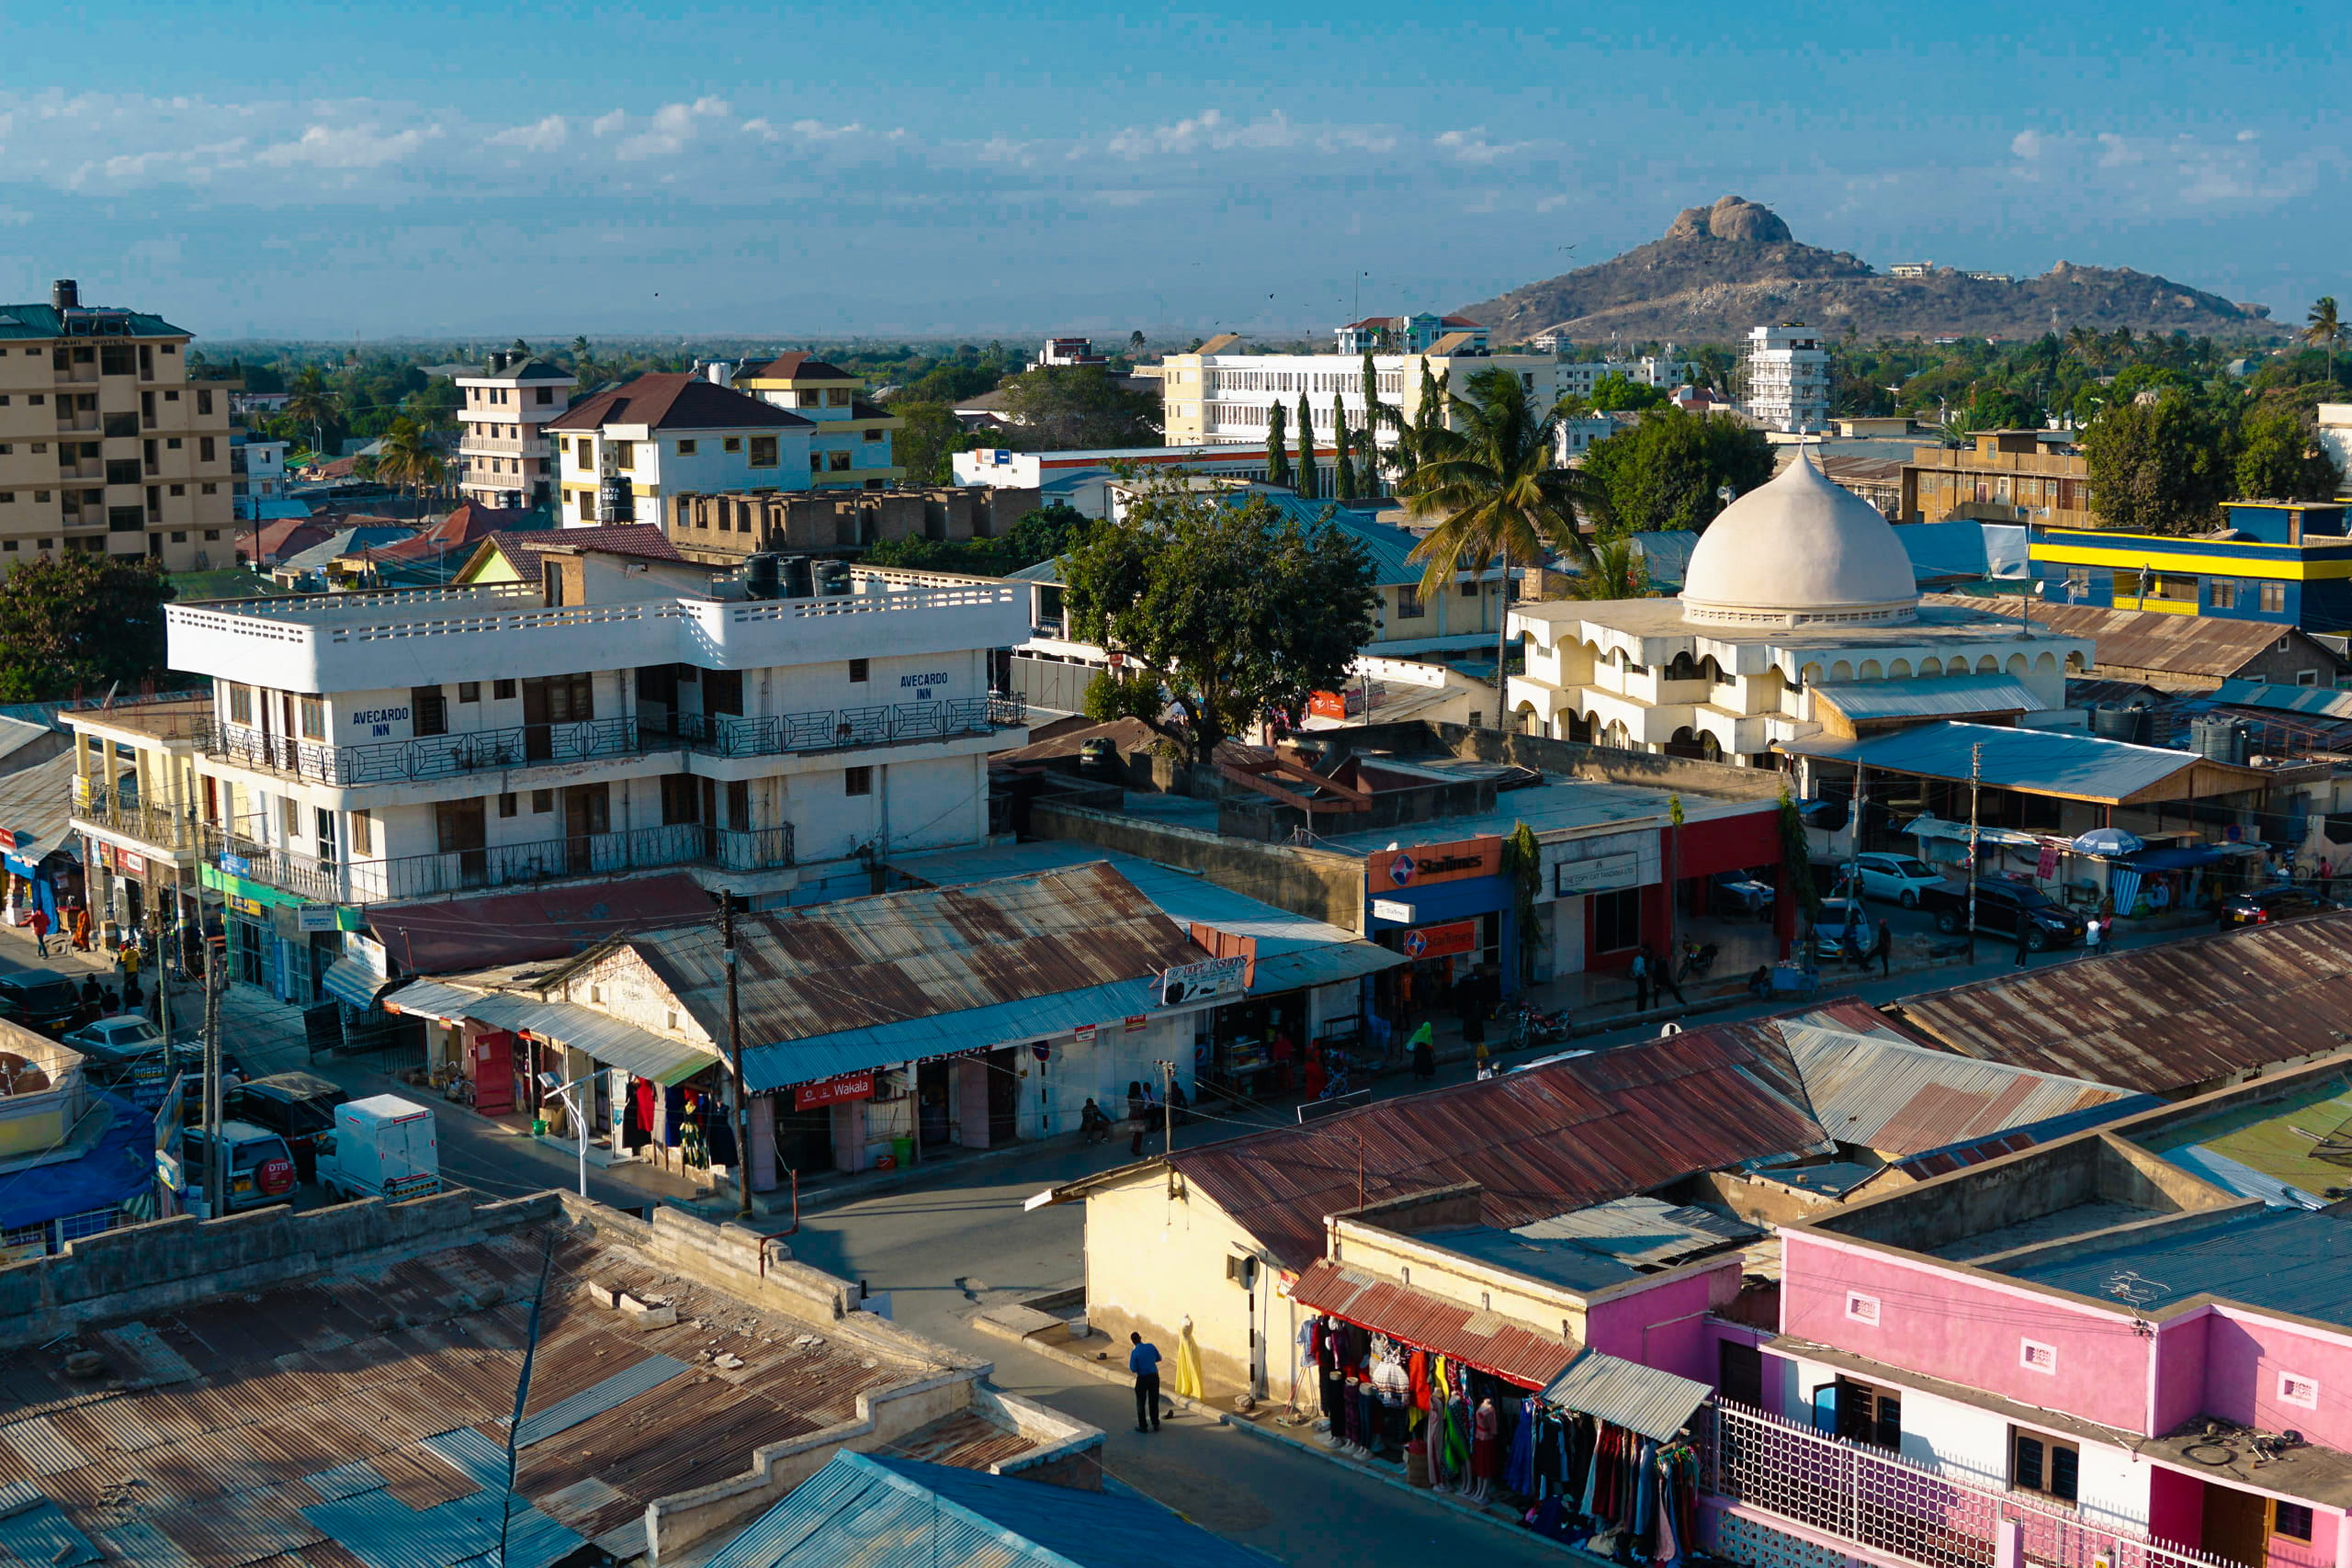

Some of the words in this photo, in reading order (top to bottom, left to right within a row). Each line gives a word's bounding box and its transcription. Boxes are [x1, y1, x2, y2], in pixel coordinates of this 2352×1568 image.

[900, 671, 948, 688] AVECARDO
[916, 688, 932, 700] INN
[353, 706, 409, 725] AVECARDO
[372, 723, 390, 737] INN
[1418, 854, 1482, 875] StarTimes
[1426, 931, 1473, 948] StarTimes
[1184, 962, 1205, 975] HOPE
[1210, 956, 1248, 971] FASHIONS
[833, 1079, 868, 1096] Wakala
[268, 1162, 288, 1172] DTB
